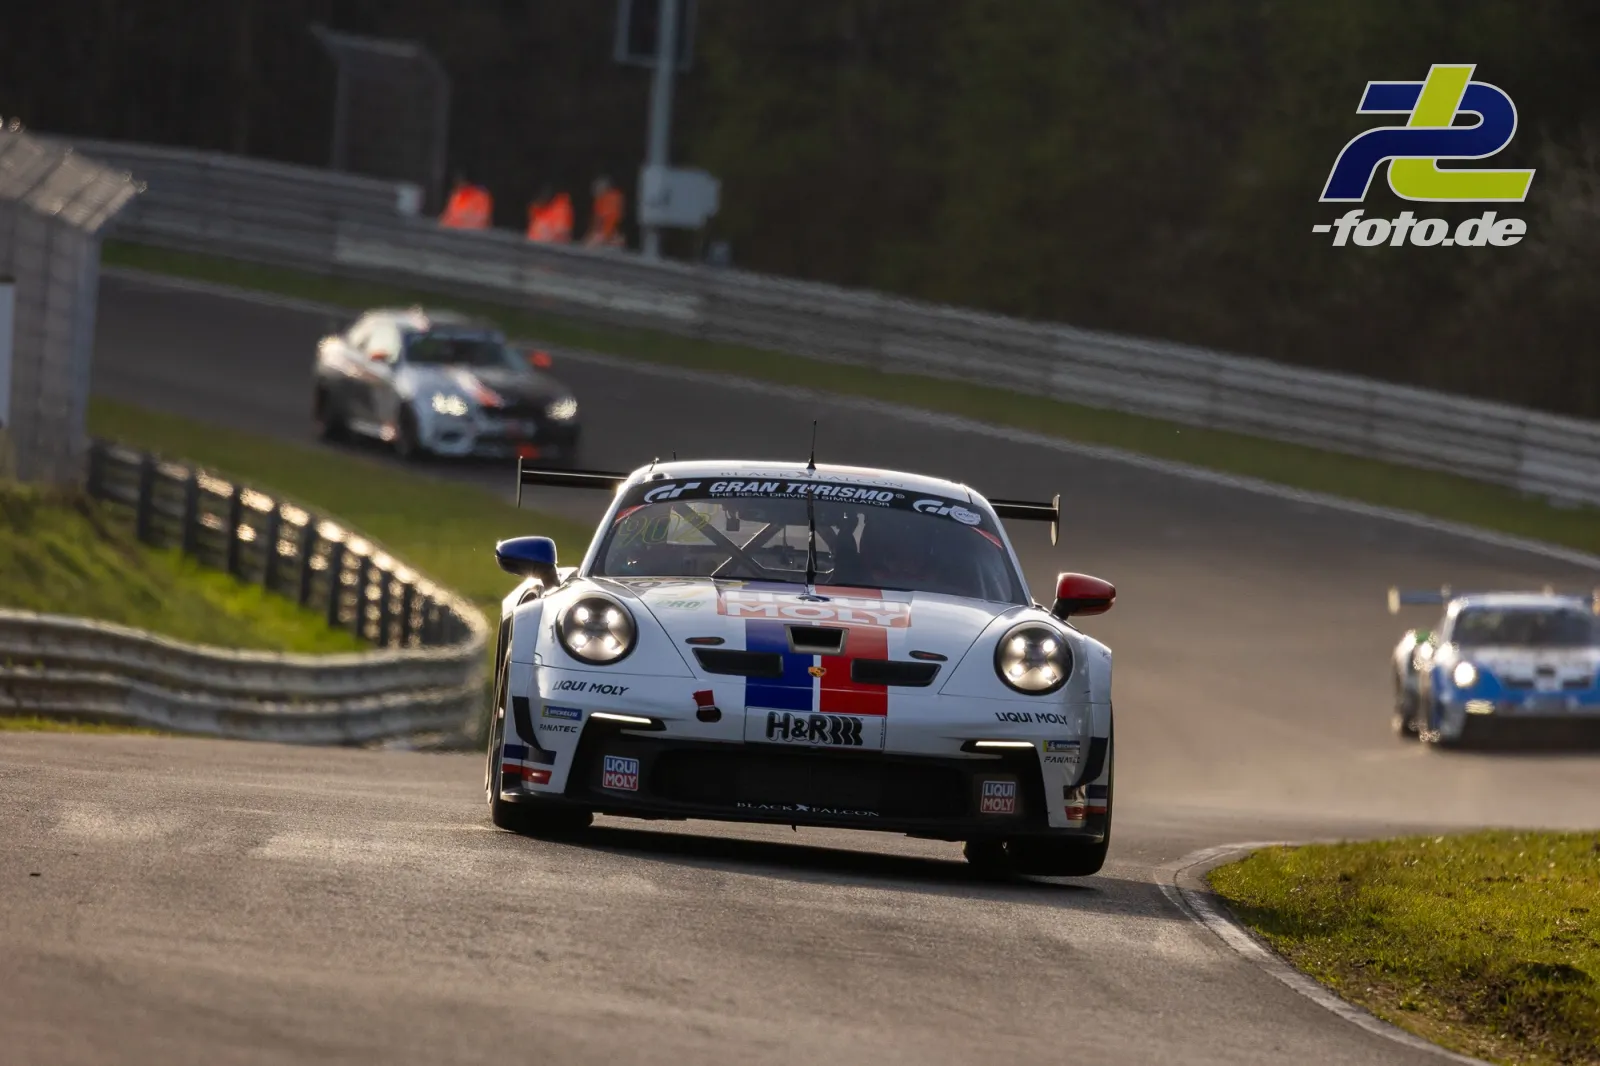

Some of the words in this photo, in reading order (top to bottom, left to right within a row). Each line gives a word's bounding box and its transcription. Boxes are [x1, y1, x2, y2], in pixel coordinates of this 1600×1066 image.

[709, 481, 780, 494] GRAN
[821, 495, 890, 508] SIMULATOR
[727, 602, 906, 626] MOLY
[552, 680, 587, 693] LIQUI
[588, 683, 629, 696] MOLY
[995, 712, 1033, 723] LIQUI
[1035, 713, 1068, 725] MOLY
[539, 723, 578, 733] FANATEC
[605, 757, 637, 773] LIQUI
[604, 773, 637, 788] MOLY
[984, 783, 1015, 797] LIQUI
[736, 802, 793, 811] BLACK
[811, 806, 880, 817] FALCON
[982, 797, 1014, 811] MOLY
